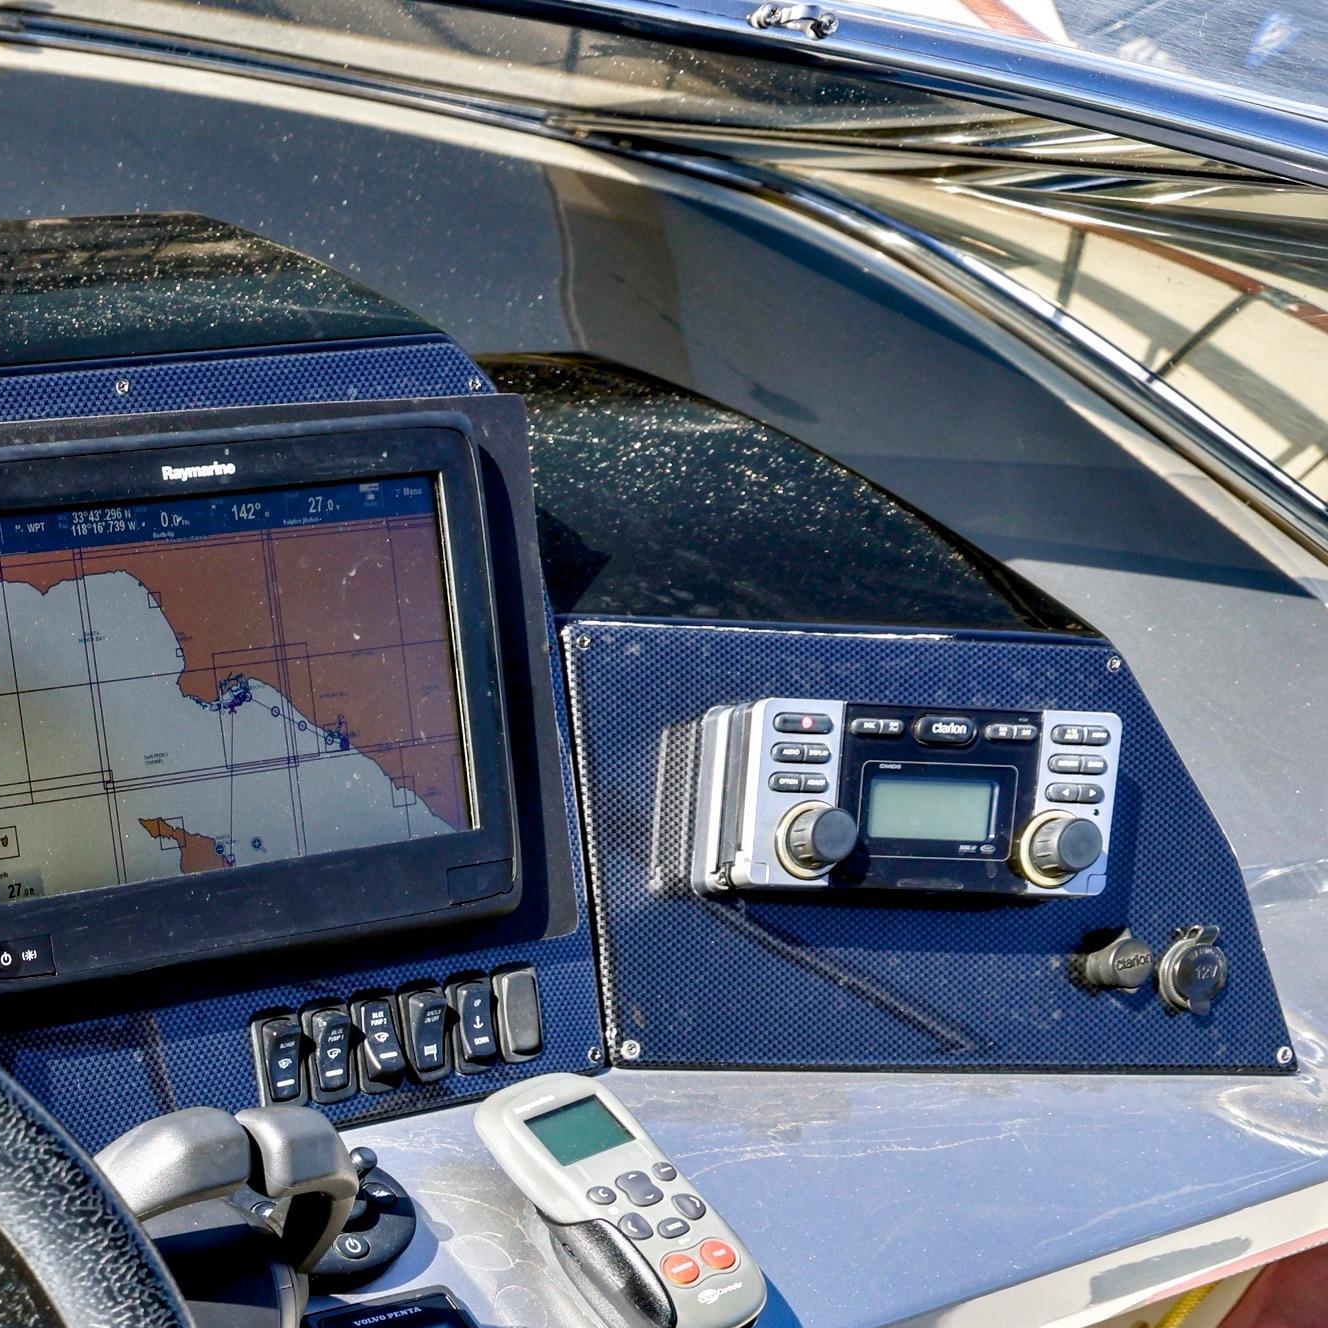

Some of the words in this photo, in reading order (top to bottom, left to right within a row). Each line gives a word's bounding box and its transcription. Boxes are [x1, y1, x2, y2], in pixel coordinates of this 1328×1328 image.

[162, 460, 236, 482] Raymarine
[27, 522, 45, 533] WPT
[932, 721, 967, 734] clarion
[1116, 953, 1153, 971] clarion
[353, 1312, 387, 1328] VOLVO
[387, 1304, 422, 1320] PENTA
